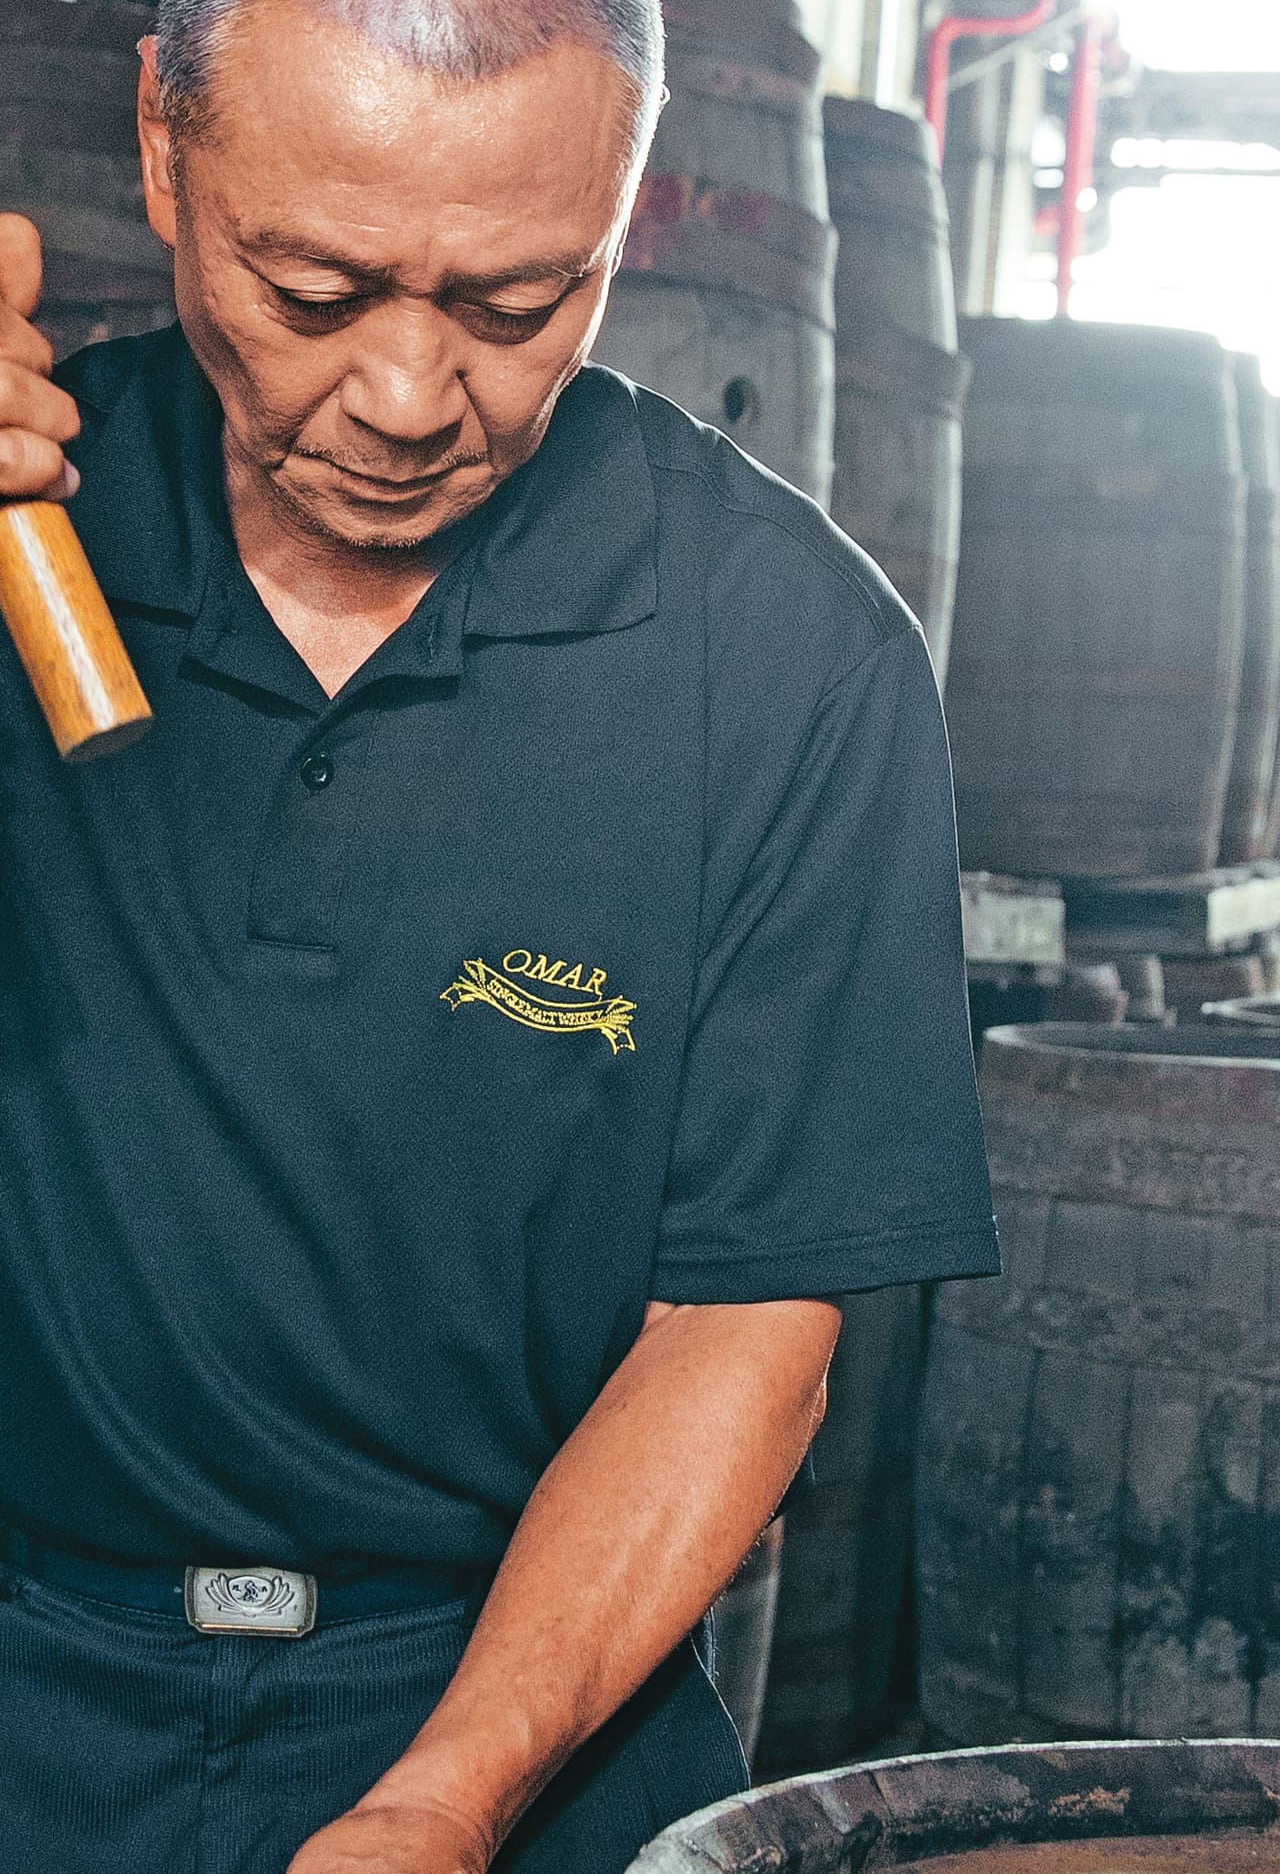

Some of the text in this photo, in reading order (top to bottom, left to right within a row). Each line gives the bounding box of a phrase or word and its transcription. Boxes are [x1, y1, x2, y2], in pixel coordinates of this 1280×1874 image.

[502, 949, 608, 994] OMAR
[486, 979, 530, 1016] SINGLE
[525, 1007, 557, 1025] MALT
